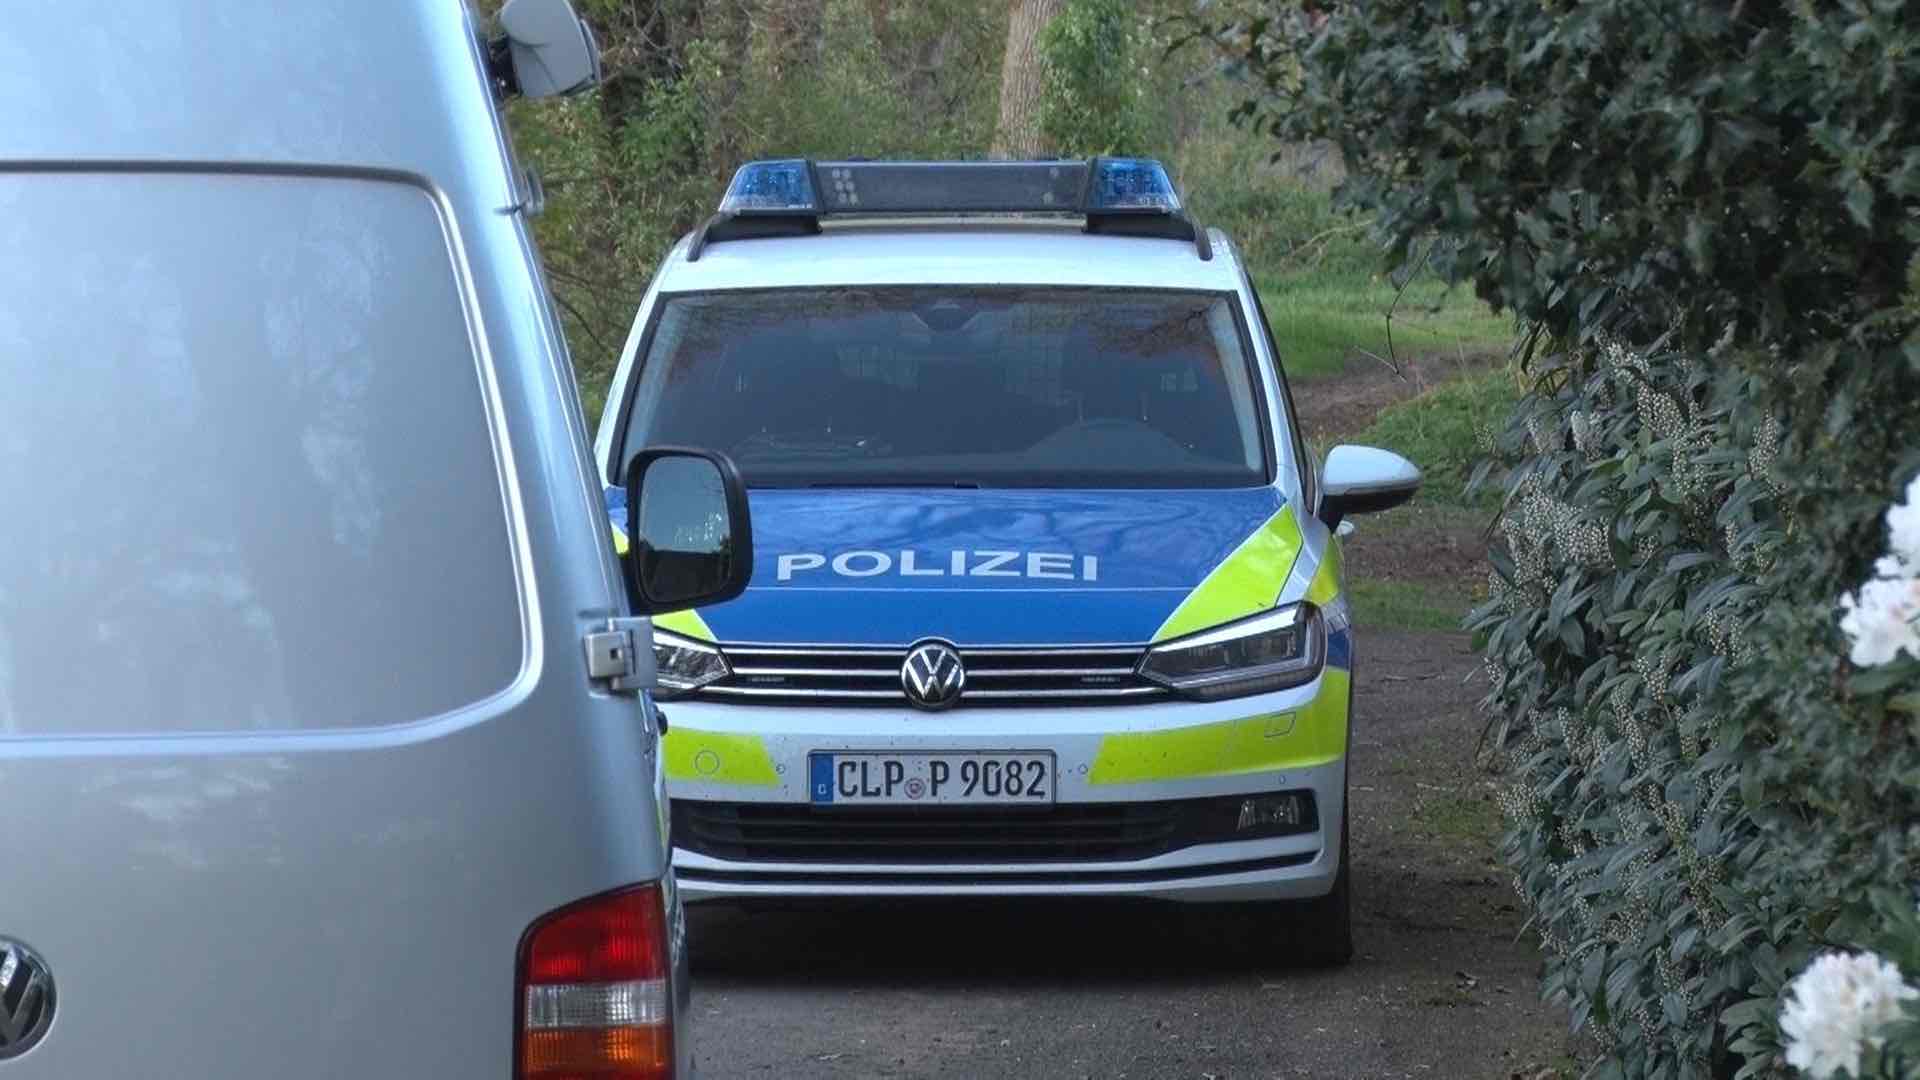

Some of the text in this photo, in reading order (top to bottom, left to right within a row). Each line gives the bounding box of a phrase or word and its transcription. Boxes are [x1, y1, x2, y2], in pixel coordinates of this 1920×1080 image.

[777, 550, 1097, 581] POLIZEI
[903, 646, 962, 703] VW
[838, 760, 1046, 797] CLP P 9082
